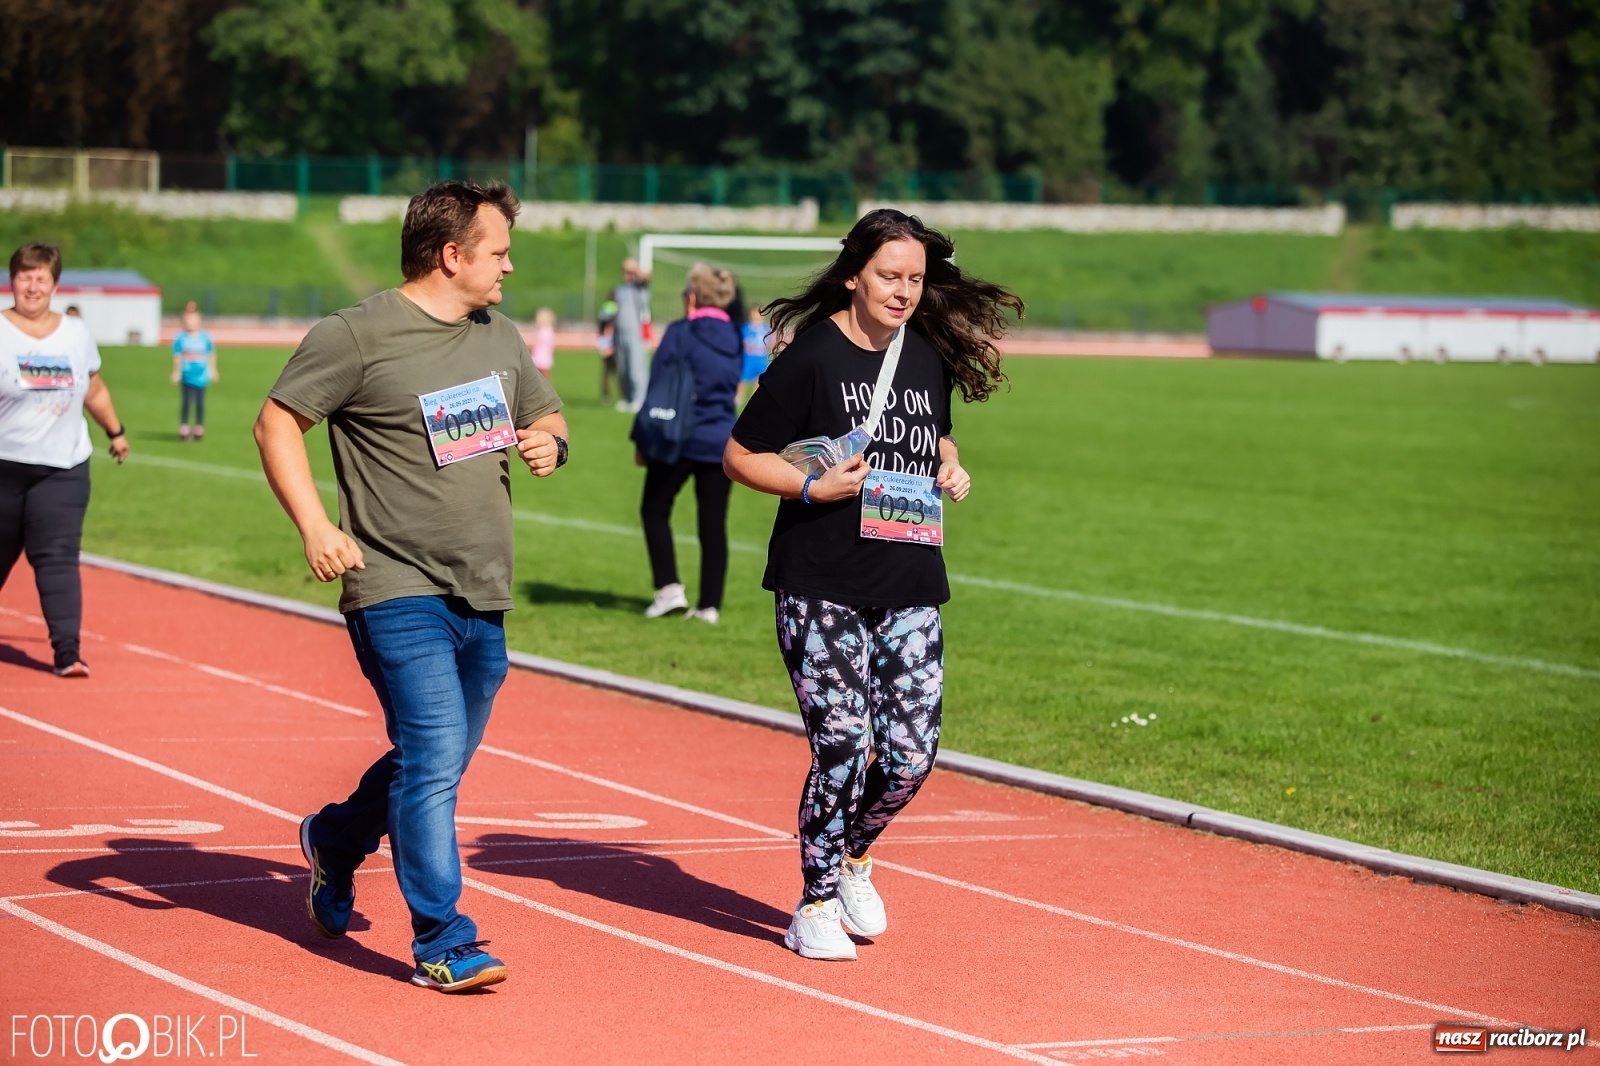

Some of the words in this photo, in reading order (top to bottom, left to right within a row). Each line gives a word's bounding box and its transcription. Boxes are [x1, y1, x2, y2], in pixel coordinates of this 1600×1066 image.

[841, 382, 897, 413] HOD
[904, 389, 933, 416] ON
[445, 404, 494, 441] 030
[910, 424, 937, 457] ON
[889, 485, 913, 494] 26.09.2021
[879, 494, 925, 525] 023
